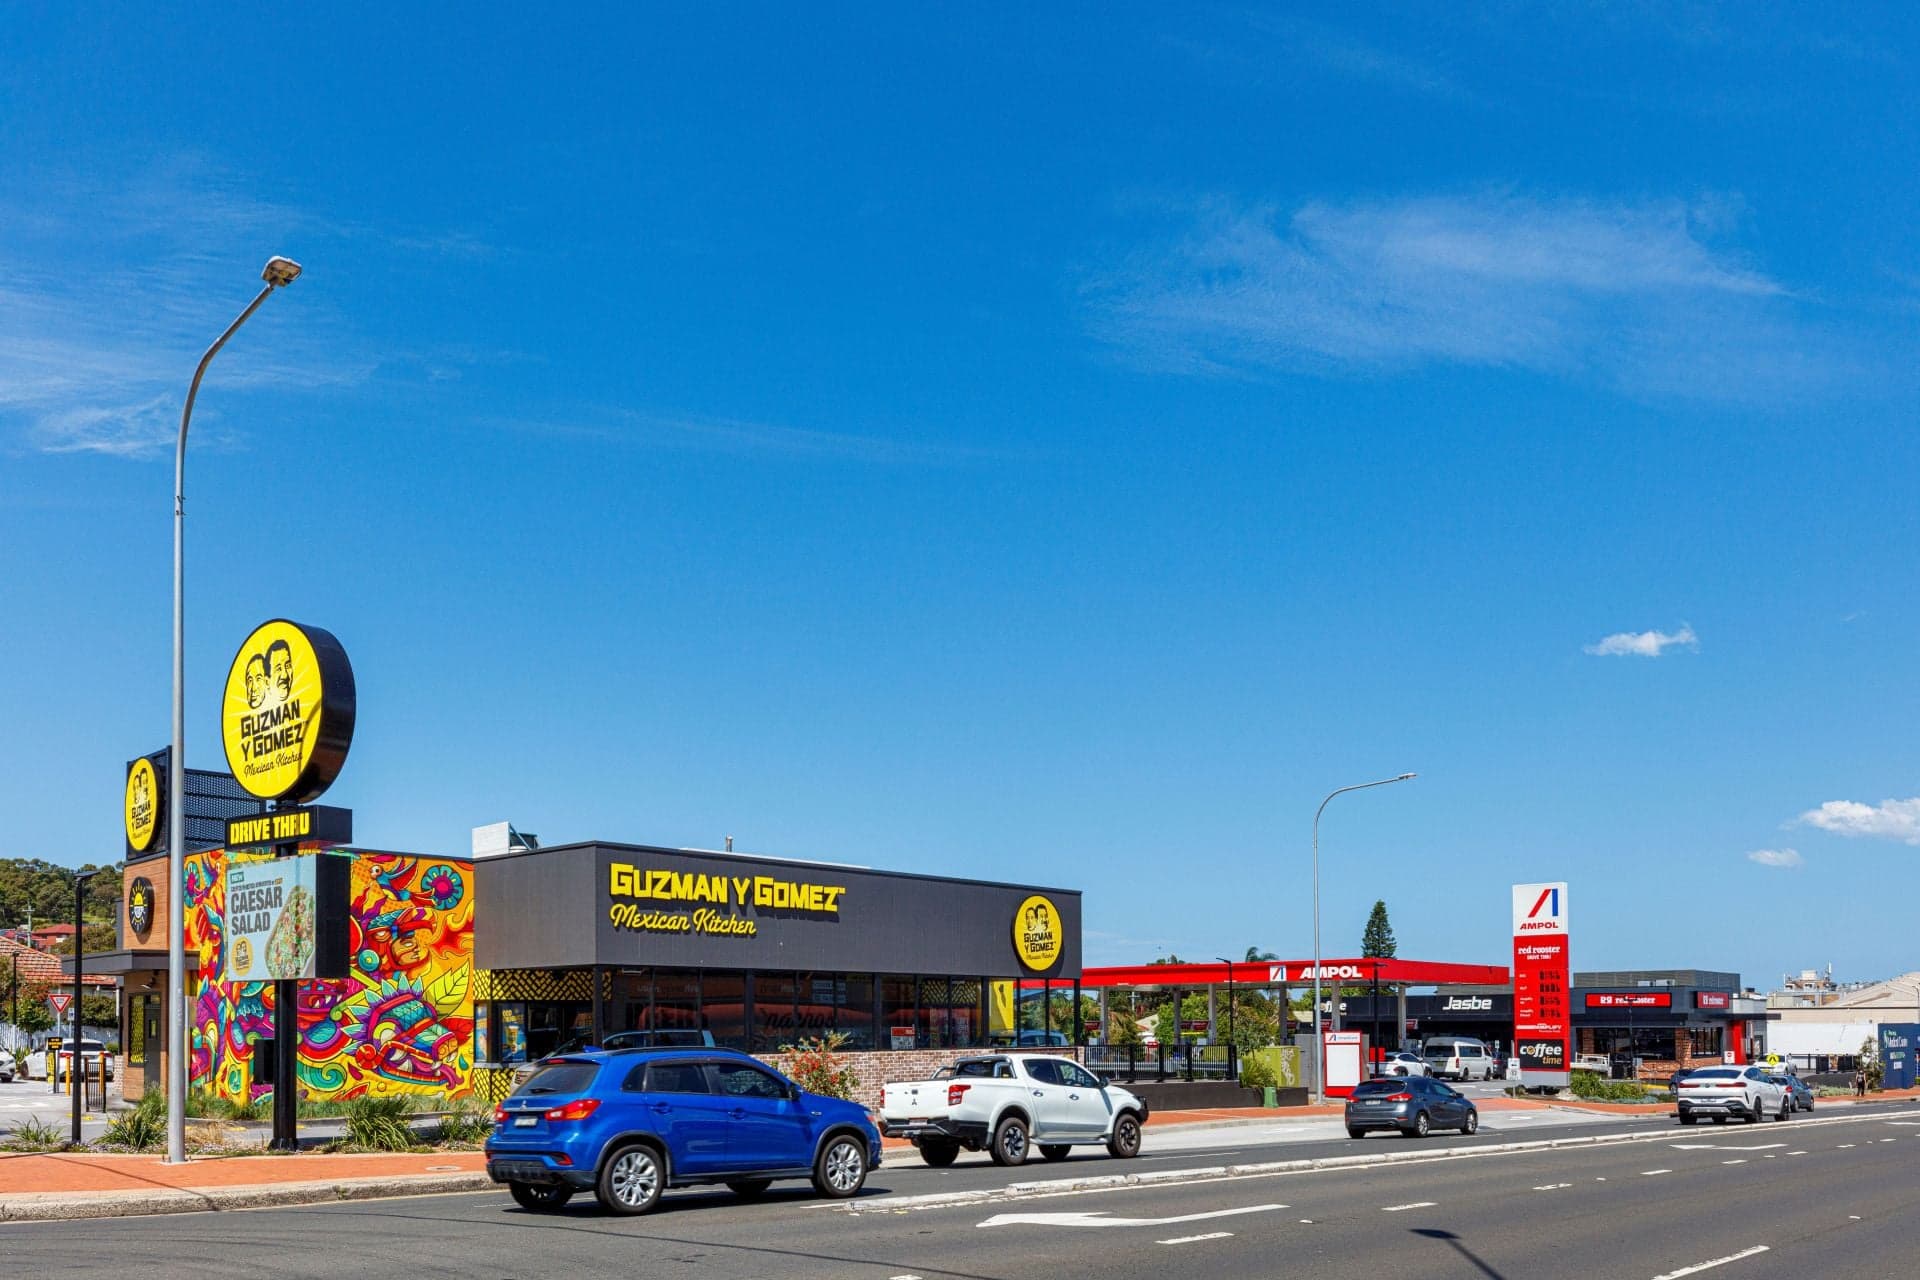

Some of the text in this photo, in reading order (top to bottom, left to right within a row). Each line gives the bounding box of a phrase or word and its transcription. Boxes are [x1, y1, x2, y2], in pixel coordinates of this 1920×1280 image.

[241, 699, 300, 739] GUZMAN
[241, 722, 304, 761] Y GOMEZ
[244, 762, 275, 777] Mexican
[230, 812, 310, 845] DRIVE THRU
[610, 863, 840, 912] GUZMAN Y GOMEZ
[231, 886, 282, 914] CAESAR
[231, 911, 271, 935] SALAD
[609, 904, 756, 934] Mexican Kitchen
[1520, 921, 1559, 930] AMPOL
[1024, 932, 1052, 942] GUZMAN
[1024, 944, 1029, 953] Y
[1300, 966, 1363, 979] AMPOL
[1442, 996, 1492, 1010] Jasbe
[1520, 1043, 1562, 1057] coffee
[1542, 1056, 1562, 1064] time
